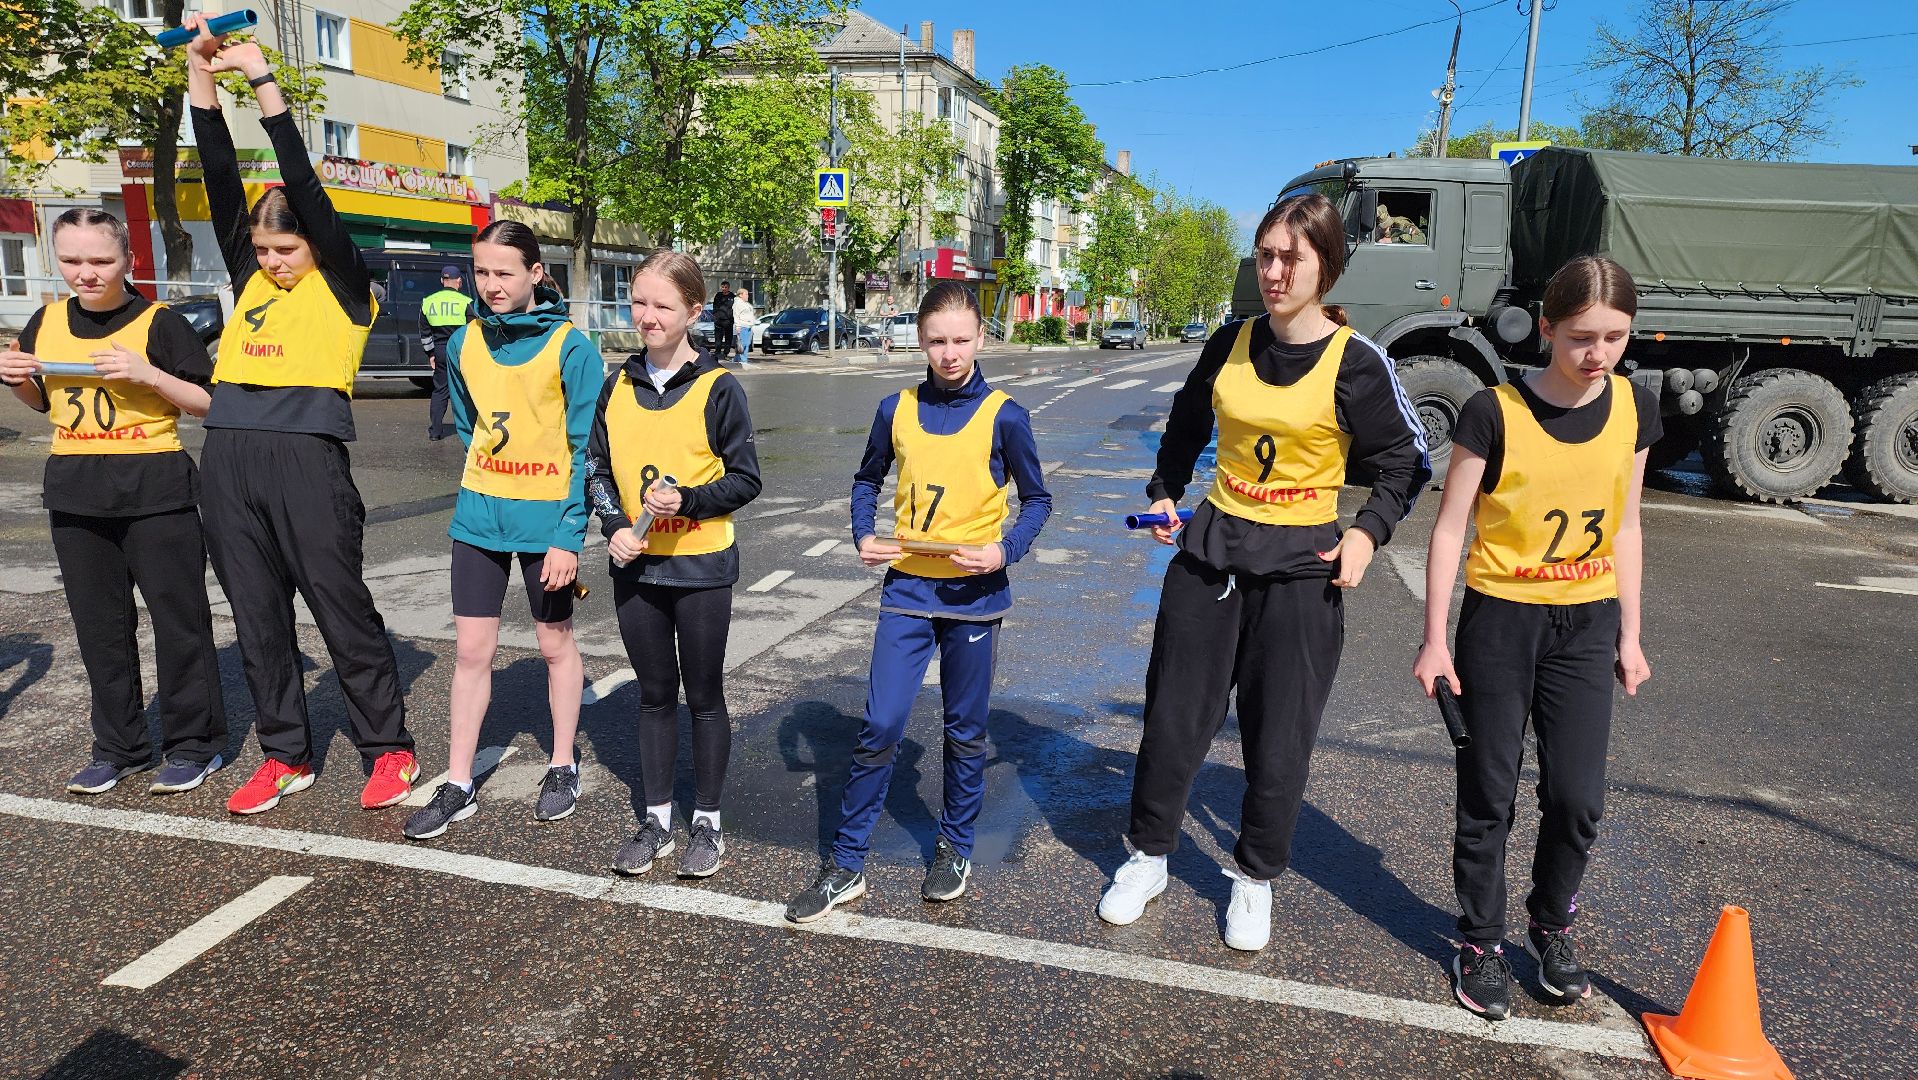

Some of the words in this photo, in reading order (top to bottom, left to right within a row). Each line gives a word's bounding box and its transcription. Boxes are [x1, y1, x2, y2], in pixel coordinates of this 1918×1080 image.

[322, 160, 388, 188] ОВОЩИ
[402, 170, 468, 198] ФРУКТЫ
[244, 297, 278, 333] 4
[428, 301, 461, 317] ДПС
[64, 386, 116, 432] 30
[491, 411, 511, 456] 3
[475, 453, 560, 477] КАШИРА
[1254, 434, 1277, 483] 9
[910, 482, 946, 533] 17
[1541, 508, 1606, 564] 23
[1514, 557, 1612, 581] КАШИРА
